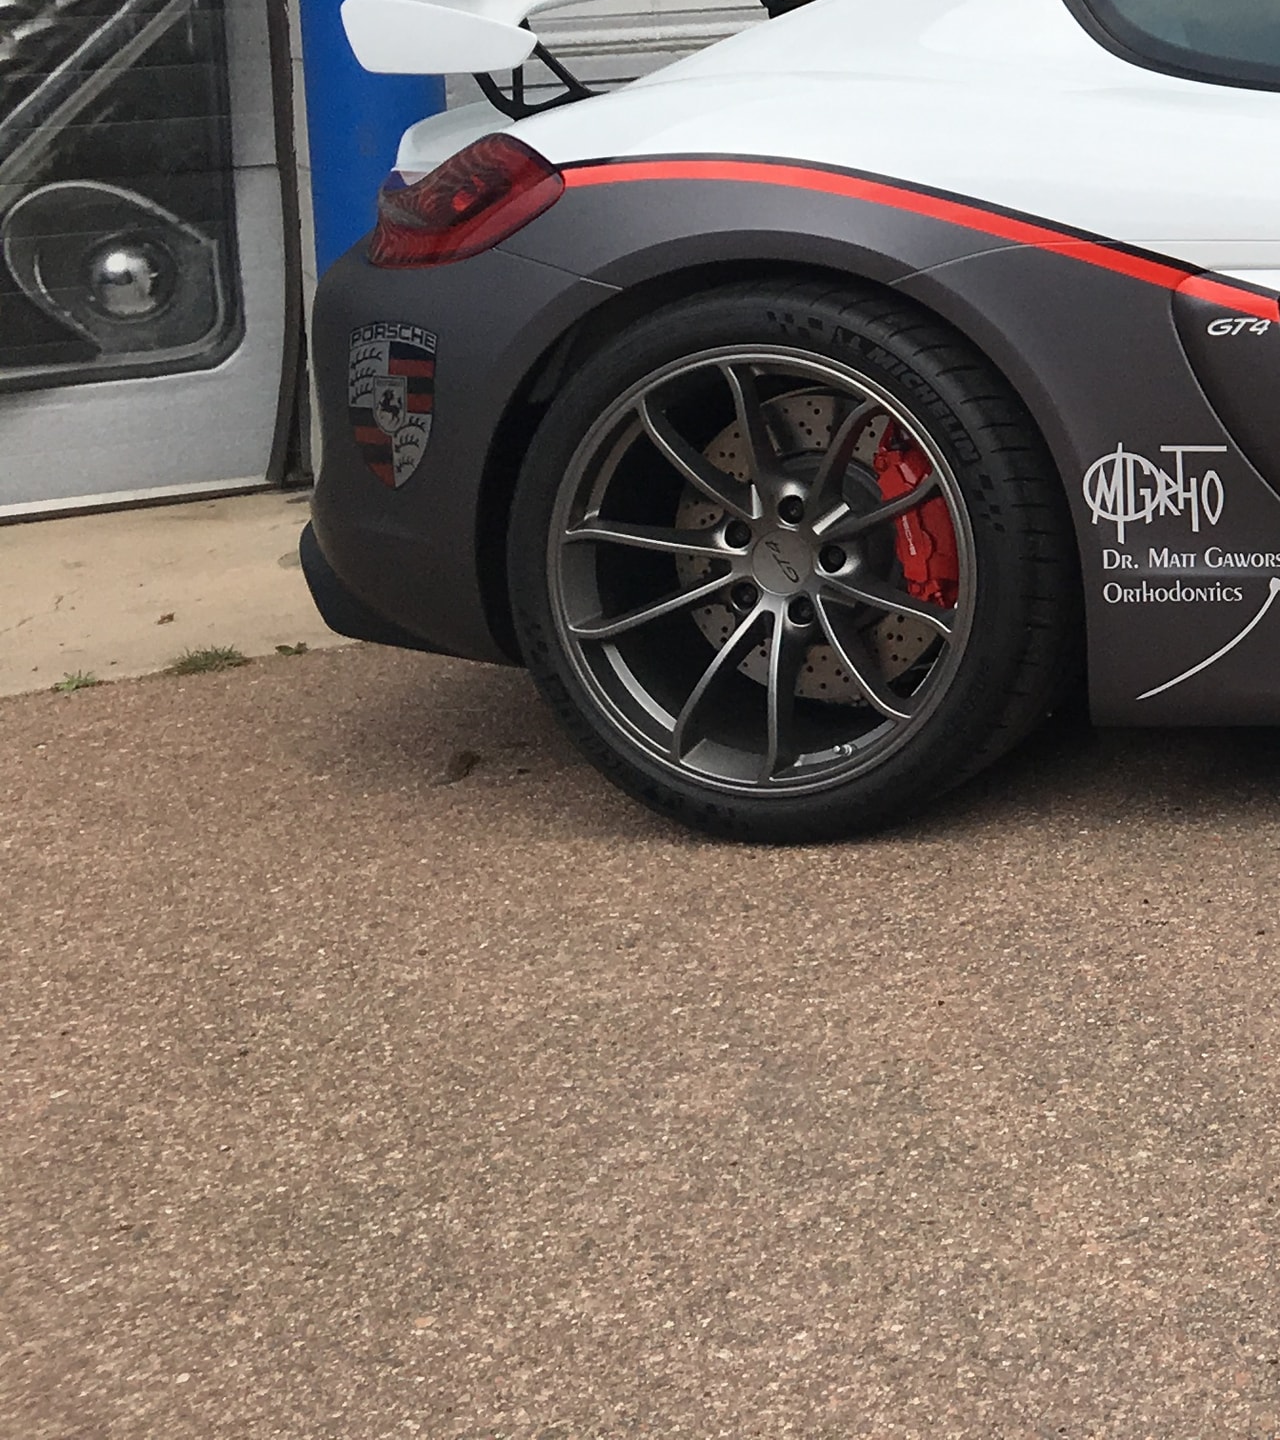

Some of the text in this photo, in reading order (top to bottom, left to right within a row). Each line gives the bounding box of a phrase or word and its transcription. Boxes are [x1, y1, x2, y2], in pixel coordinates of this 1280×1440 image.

[351, 324, 436, 349] PORSCHE
[1207, 317, 1271, 336] GT4
[1102, 579, 1243, 604] Orthodontics
